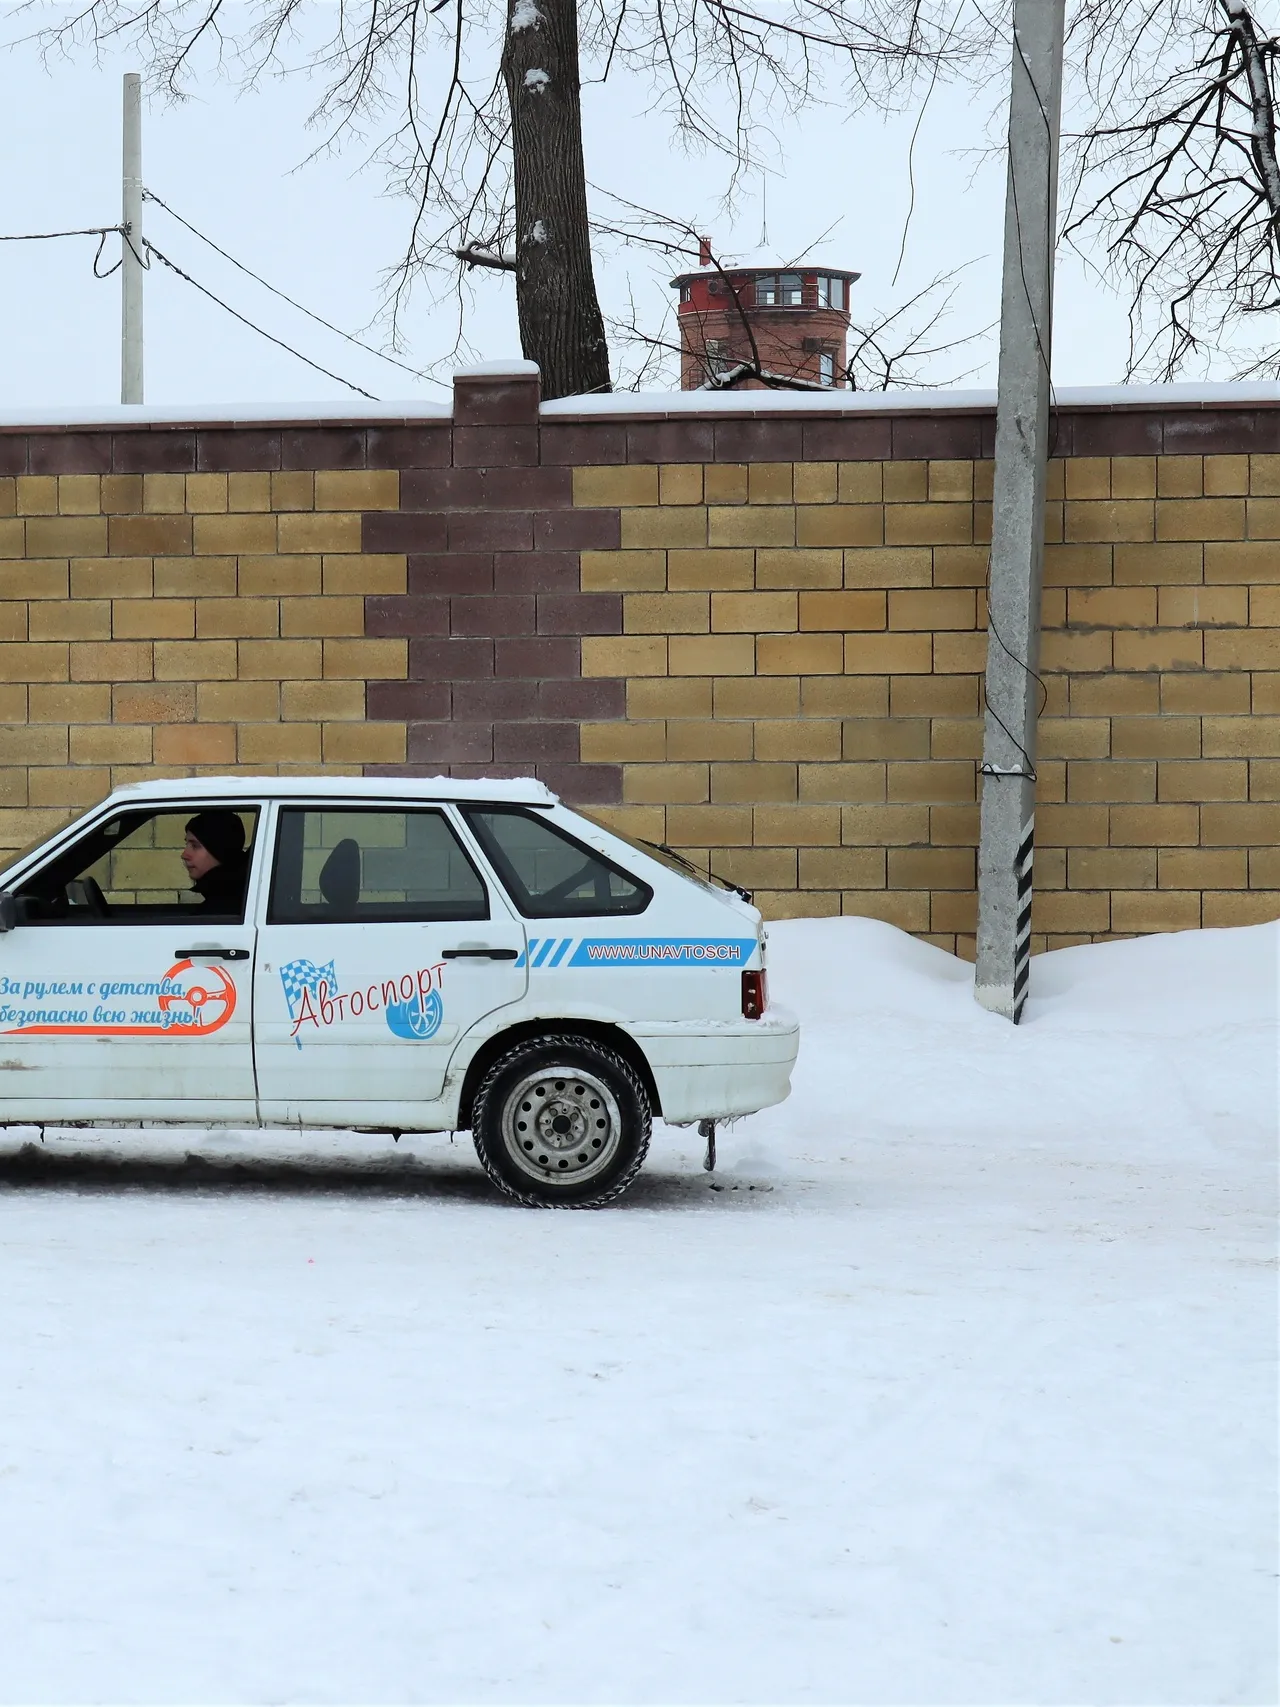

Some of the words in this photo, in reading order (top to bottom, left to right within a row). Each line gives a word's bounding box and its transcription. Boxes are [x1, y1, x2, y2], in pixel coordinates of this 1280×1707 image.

[588, 945, 740, 959] WWW.UNAVTOSCH
[22, 980, 83, 1000] рулем
[86, 981, 96, 996] с
[99, 976, 187, 1000] детства,
[290, 962, 448, 1037] Автоспорт
[92, 1005, 126, 1024] всю
[130, 1006, 201, 1029] жизнь!
